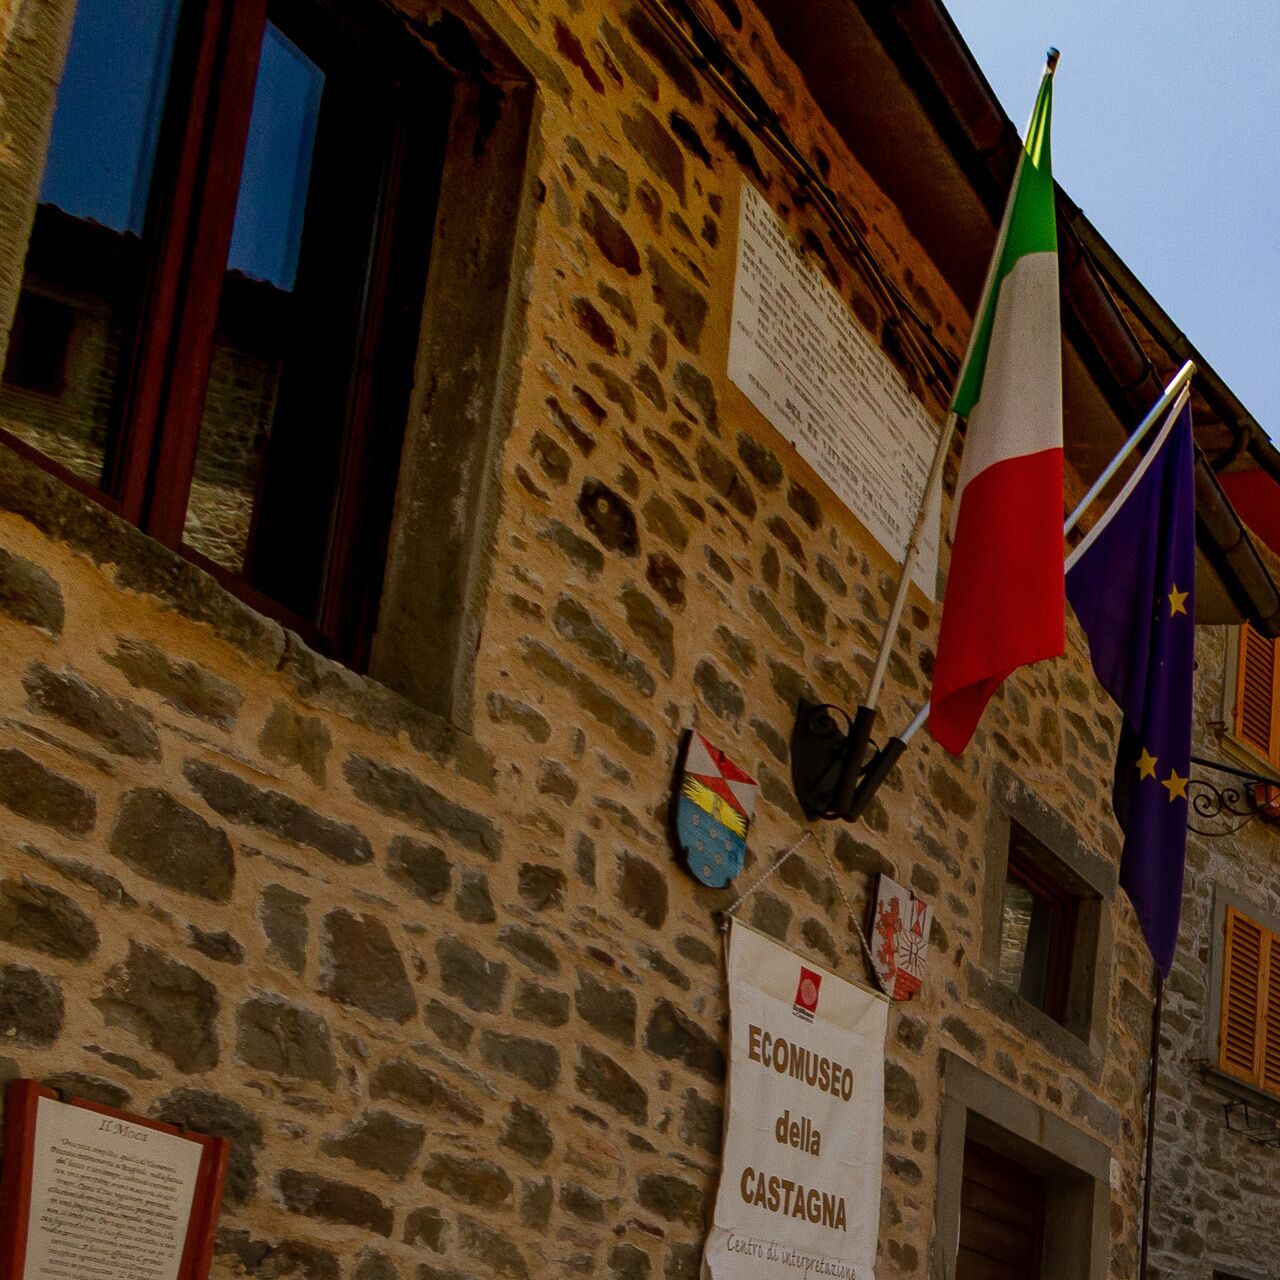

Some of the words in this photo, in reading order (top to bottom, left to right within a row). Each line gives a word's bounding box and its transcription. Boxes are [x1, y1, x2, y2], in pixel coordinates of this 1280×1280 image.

[748, 1023, 854, 1102] ECOMUSEO
[113, 1123, 148, 1143] Moca
[775, 1109, 822, 1157] della
[740, 1166, 847, 1233] CASTAGNA
[727, 1233, 763, 1259] Centro
[767, 1242, 779, 1262] di
[781, 1245, 856, 1280] interpretazione
